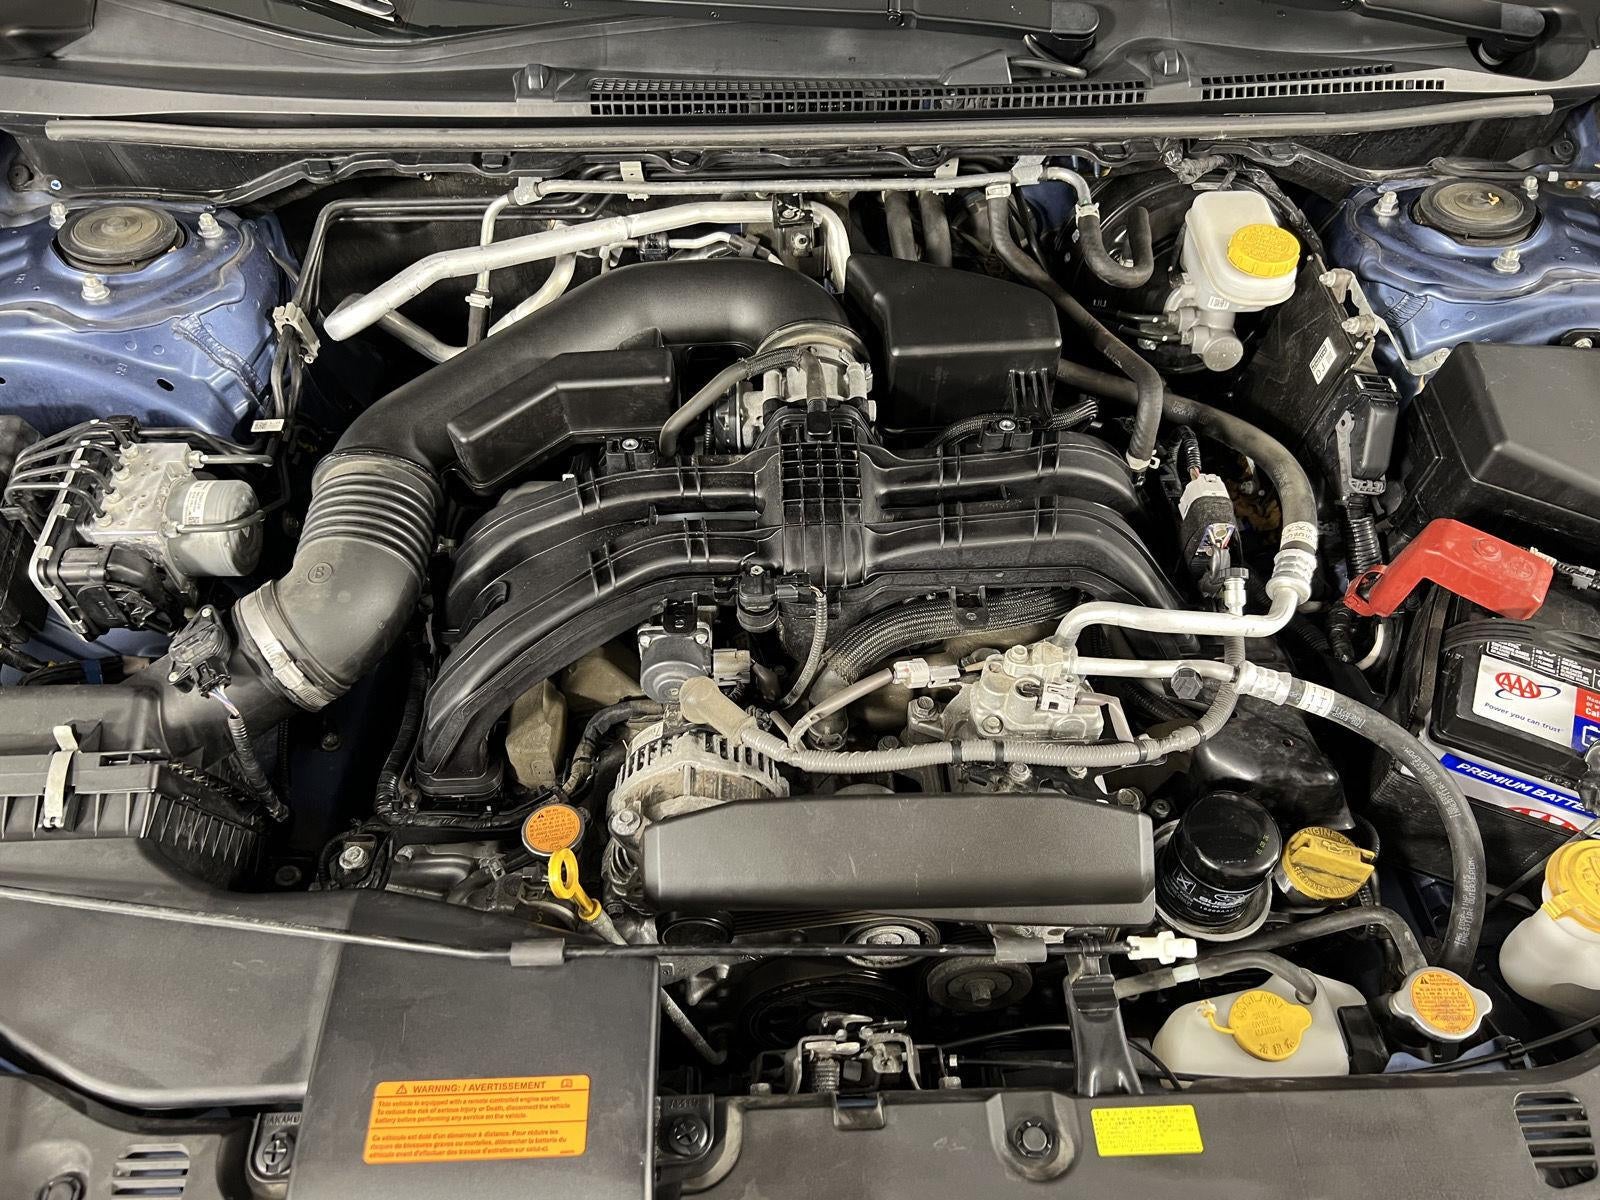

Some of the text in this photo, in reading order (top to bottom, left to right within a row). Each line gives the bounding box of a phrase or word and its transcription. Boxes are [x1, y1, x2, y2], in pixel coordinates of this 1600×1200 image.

[1500, 673, 1536, 698] AAA
[1484, 702, 1561, 733] Power you can trust
[1456, 763, 1533, 792] PREMIUM
[1532, 788, 1586, 811] BATTE
[1234, 992, 1284, 1018] COOLANT
[412, 1083, 461, 1093] WARNING:
[468, 1080, 546, 1091] AVERTISSEMENT
